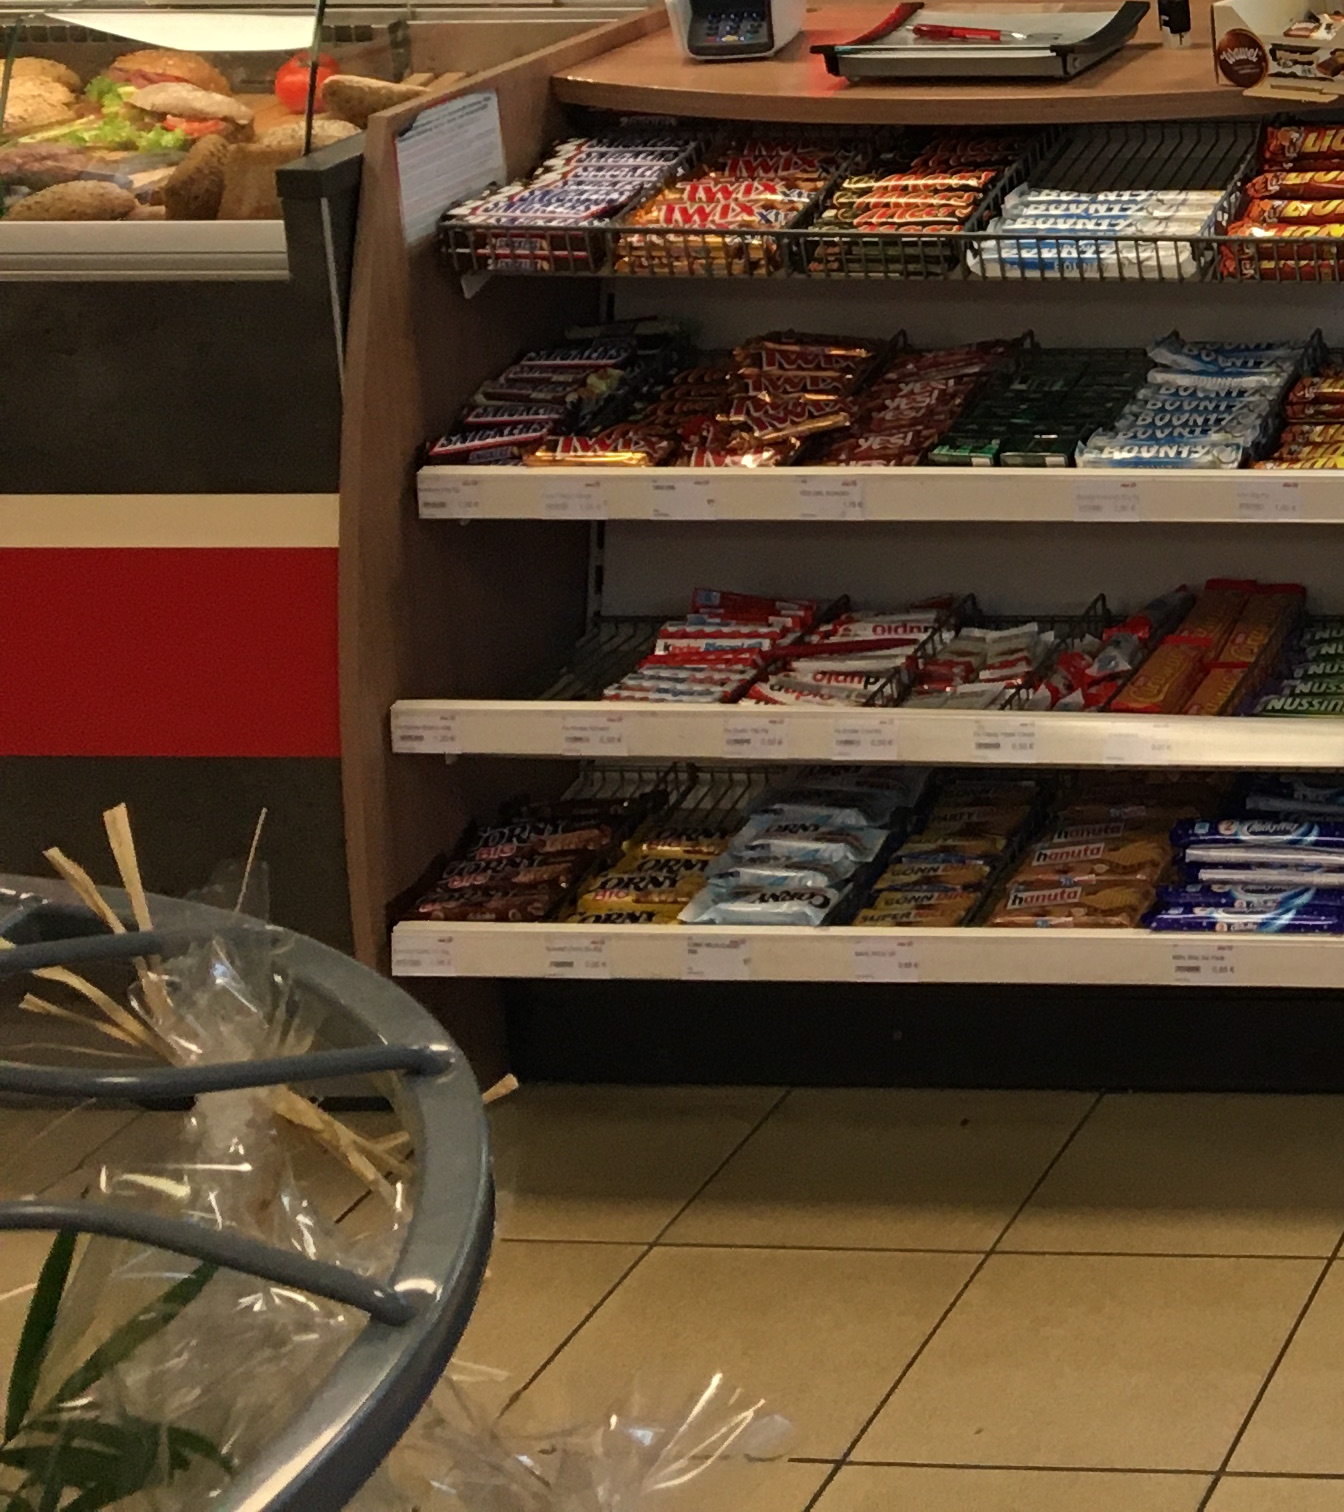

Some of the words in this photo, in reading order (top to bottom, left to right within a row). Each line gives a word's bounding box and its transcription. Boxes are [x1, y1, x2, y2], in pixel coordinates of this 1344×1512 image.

[665, 202, 756, 224] TWIX
[857, 431, 914, 449] YES!
[1100, 442, 1210, 460] BOUNTY
[1036, 846, 1103, 866] hanuta
[1011, 890, 1081, 909] hanuta
